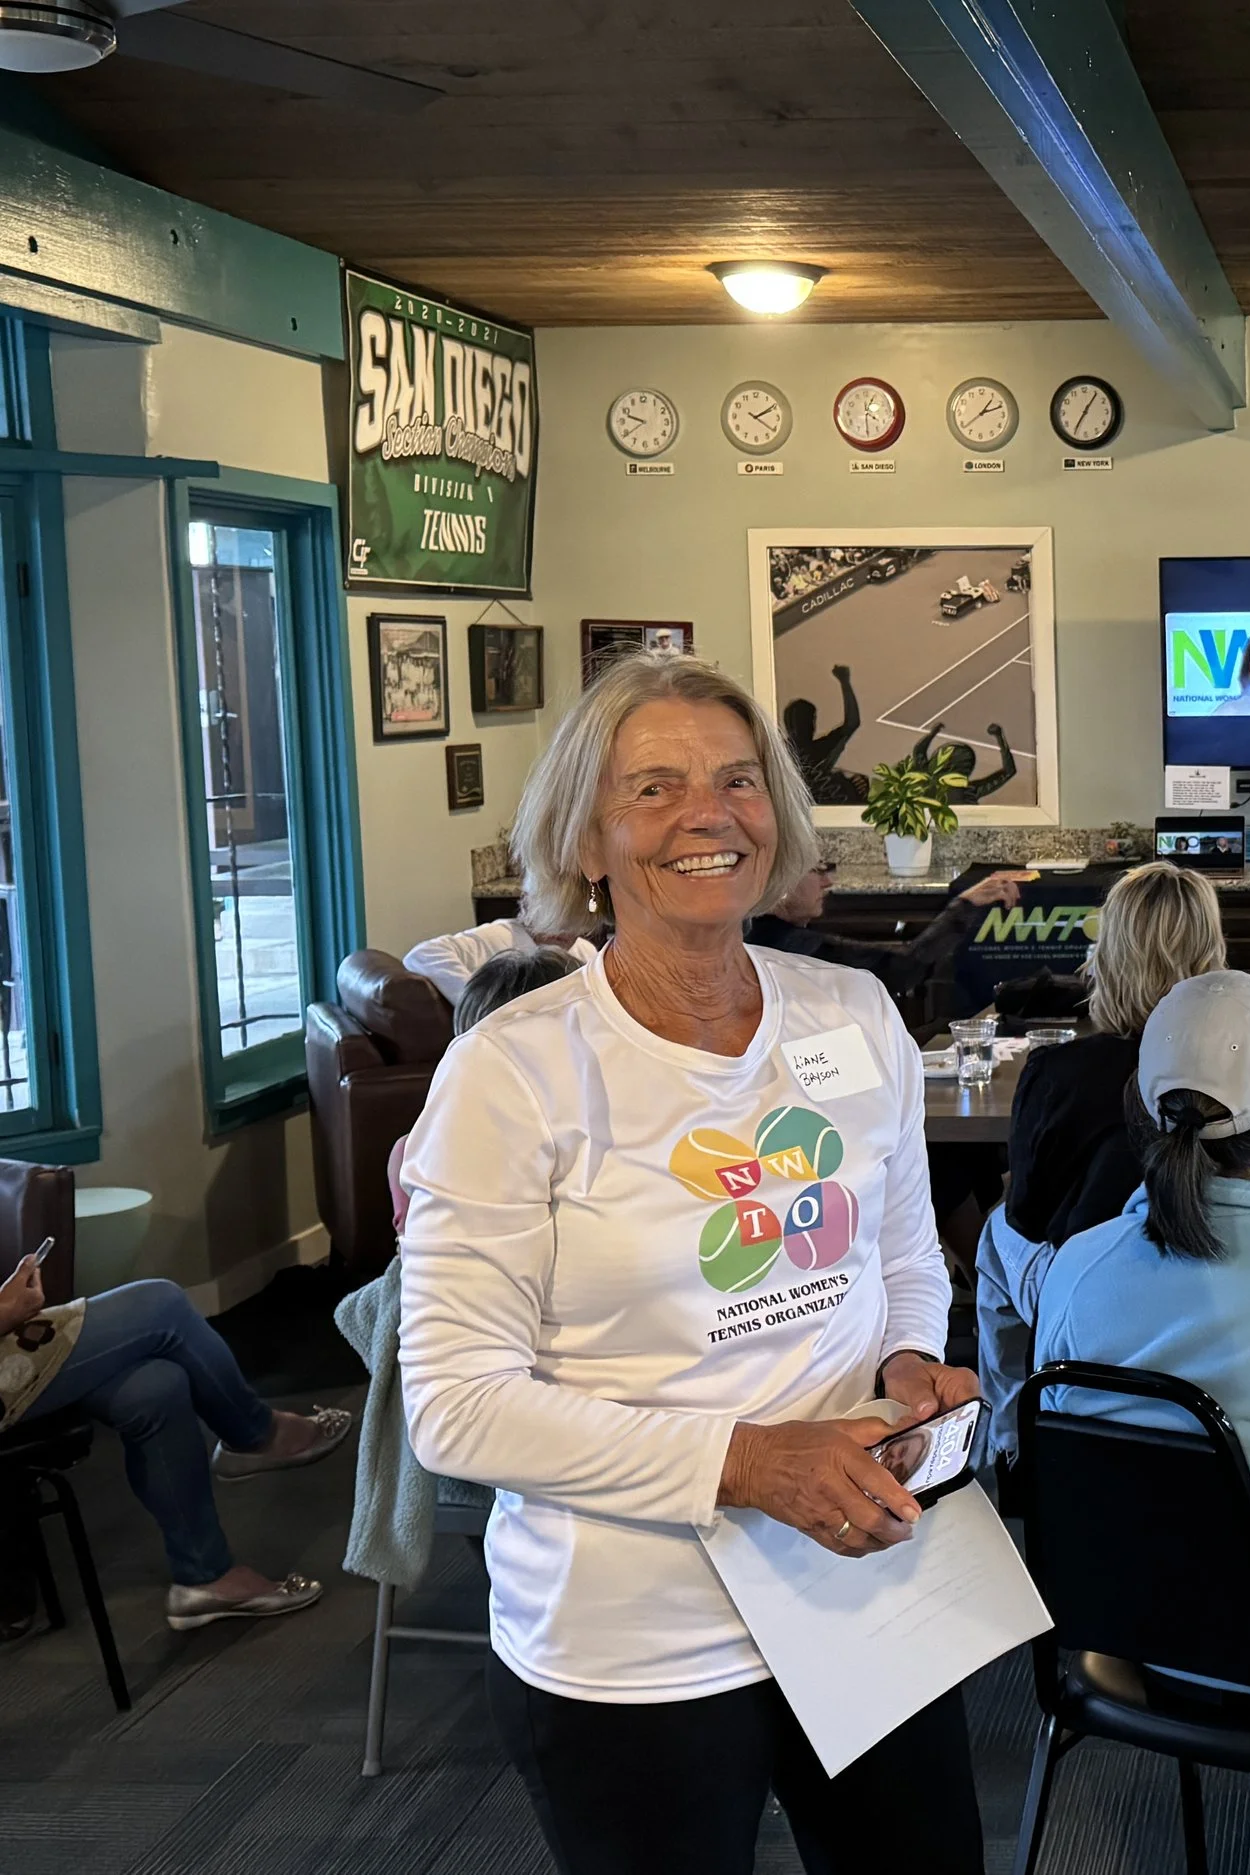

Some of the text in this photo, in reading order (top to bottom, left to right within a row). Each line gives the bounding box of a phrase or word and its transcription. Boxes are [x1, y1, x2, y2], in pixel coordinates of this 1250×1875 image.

[354, 310, 532, 480] SAN DIEGO
[413, 474, 475, 502] DIVISION
[419, 508, 487, 555] TENNIS
[801, 577, 855, 614] CADILLAC
[707, 1290, 849, 1344] TENNIS ORGANIZATI
[716, 1273, 849, 1322] NATIONAL WOMEN'S
[936, 1424, 959, 1471] 4:04
